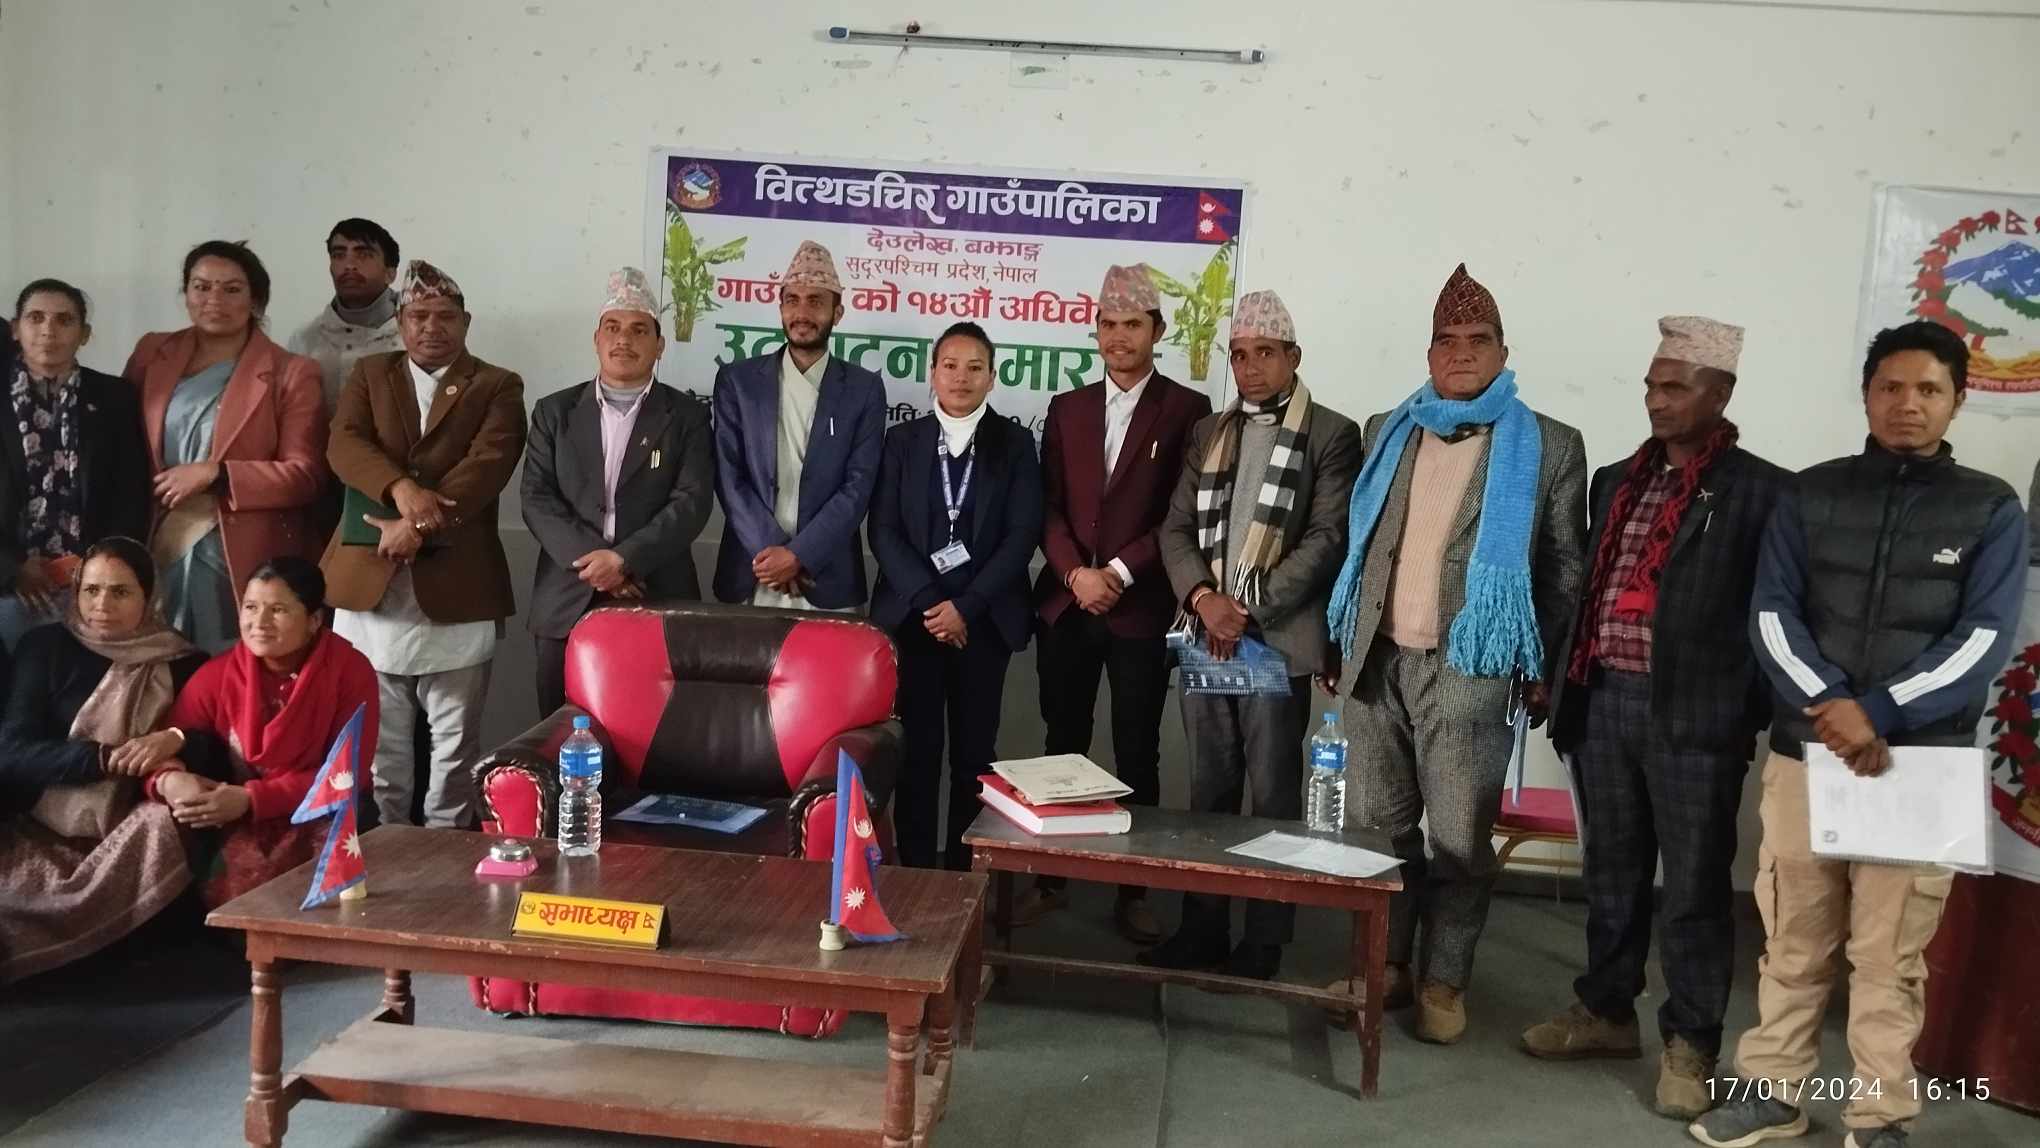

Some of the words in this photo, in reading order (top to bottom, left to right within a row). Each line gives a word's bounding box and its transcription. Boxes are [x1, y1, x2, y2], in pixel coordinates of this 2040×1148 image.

[946, 178, 1162, 225] गाउँपालिका
[845, 254, 940, 280] सुदूरपश्चिम
[992, 260, 1037, 284] नेपाल
[851, 280, 901, 313] को
[999, 290, 1099, 325] अधिवे
[539, 902, 640, 934] सभाध्यक्ष
